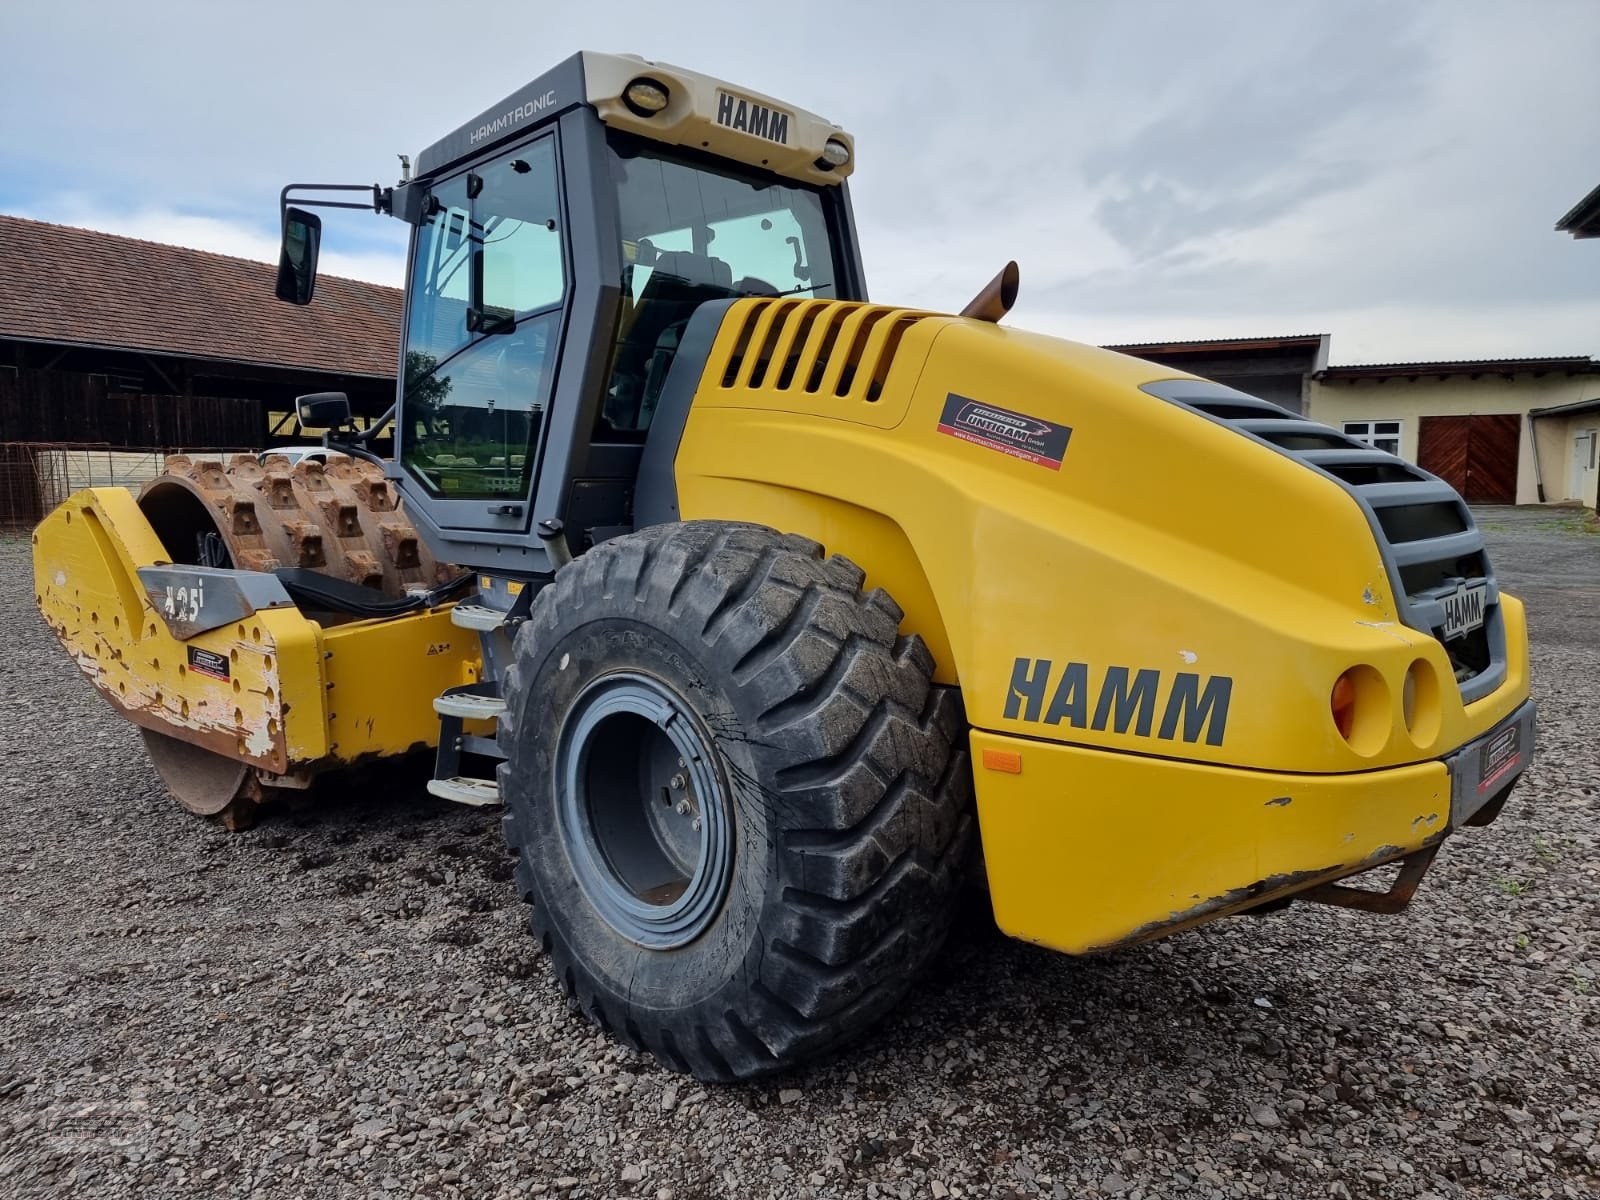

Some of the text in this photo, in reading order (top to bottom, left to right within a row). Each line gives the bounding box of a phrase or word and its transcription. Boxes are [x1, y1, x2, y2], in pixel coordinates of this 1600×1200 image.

[470, 90, 555, 144] HAMMTRONIC
[717, 93, 788, 145] HAMM
[1445, 591, 1482, 632] HAMM
[1003, 657, 1233, 747] HAMM
